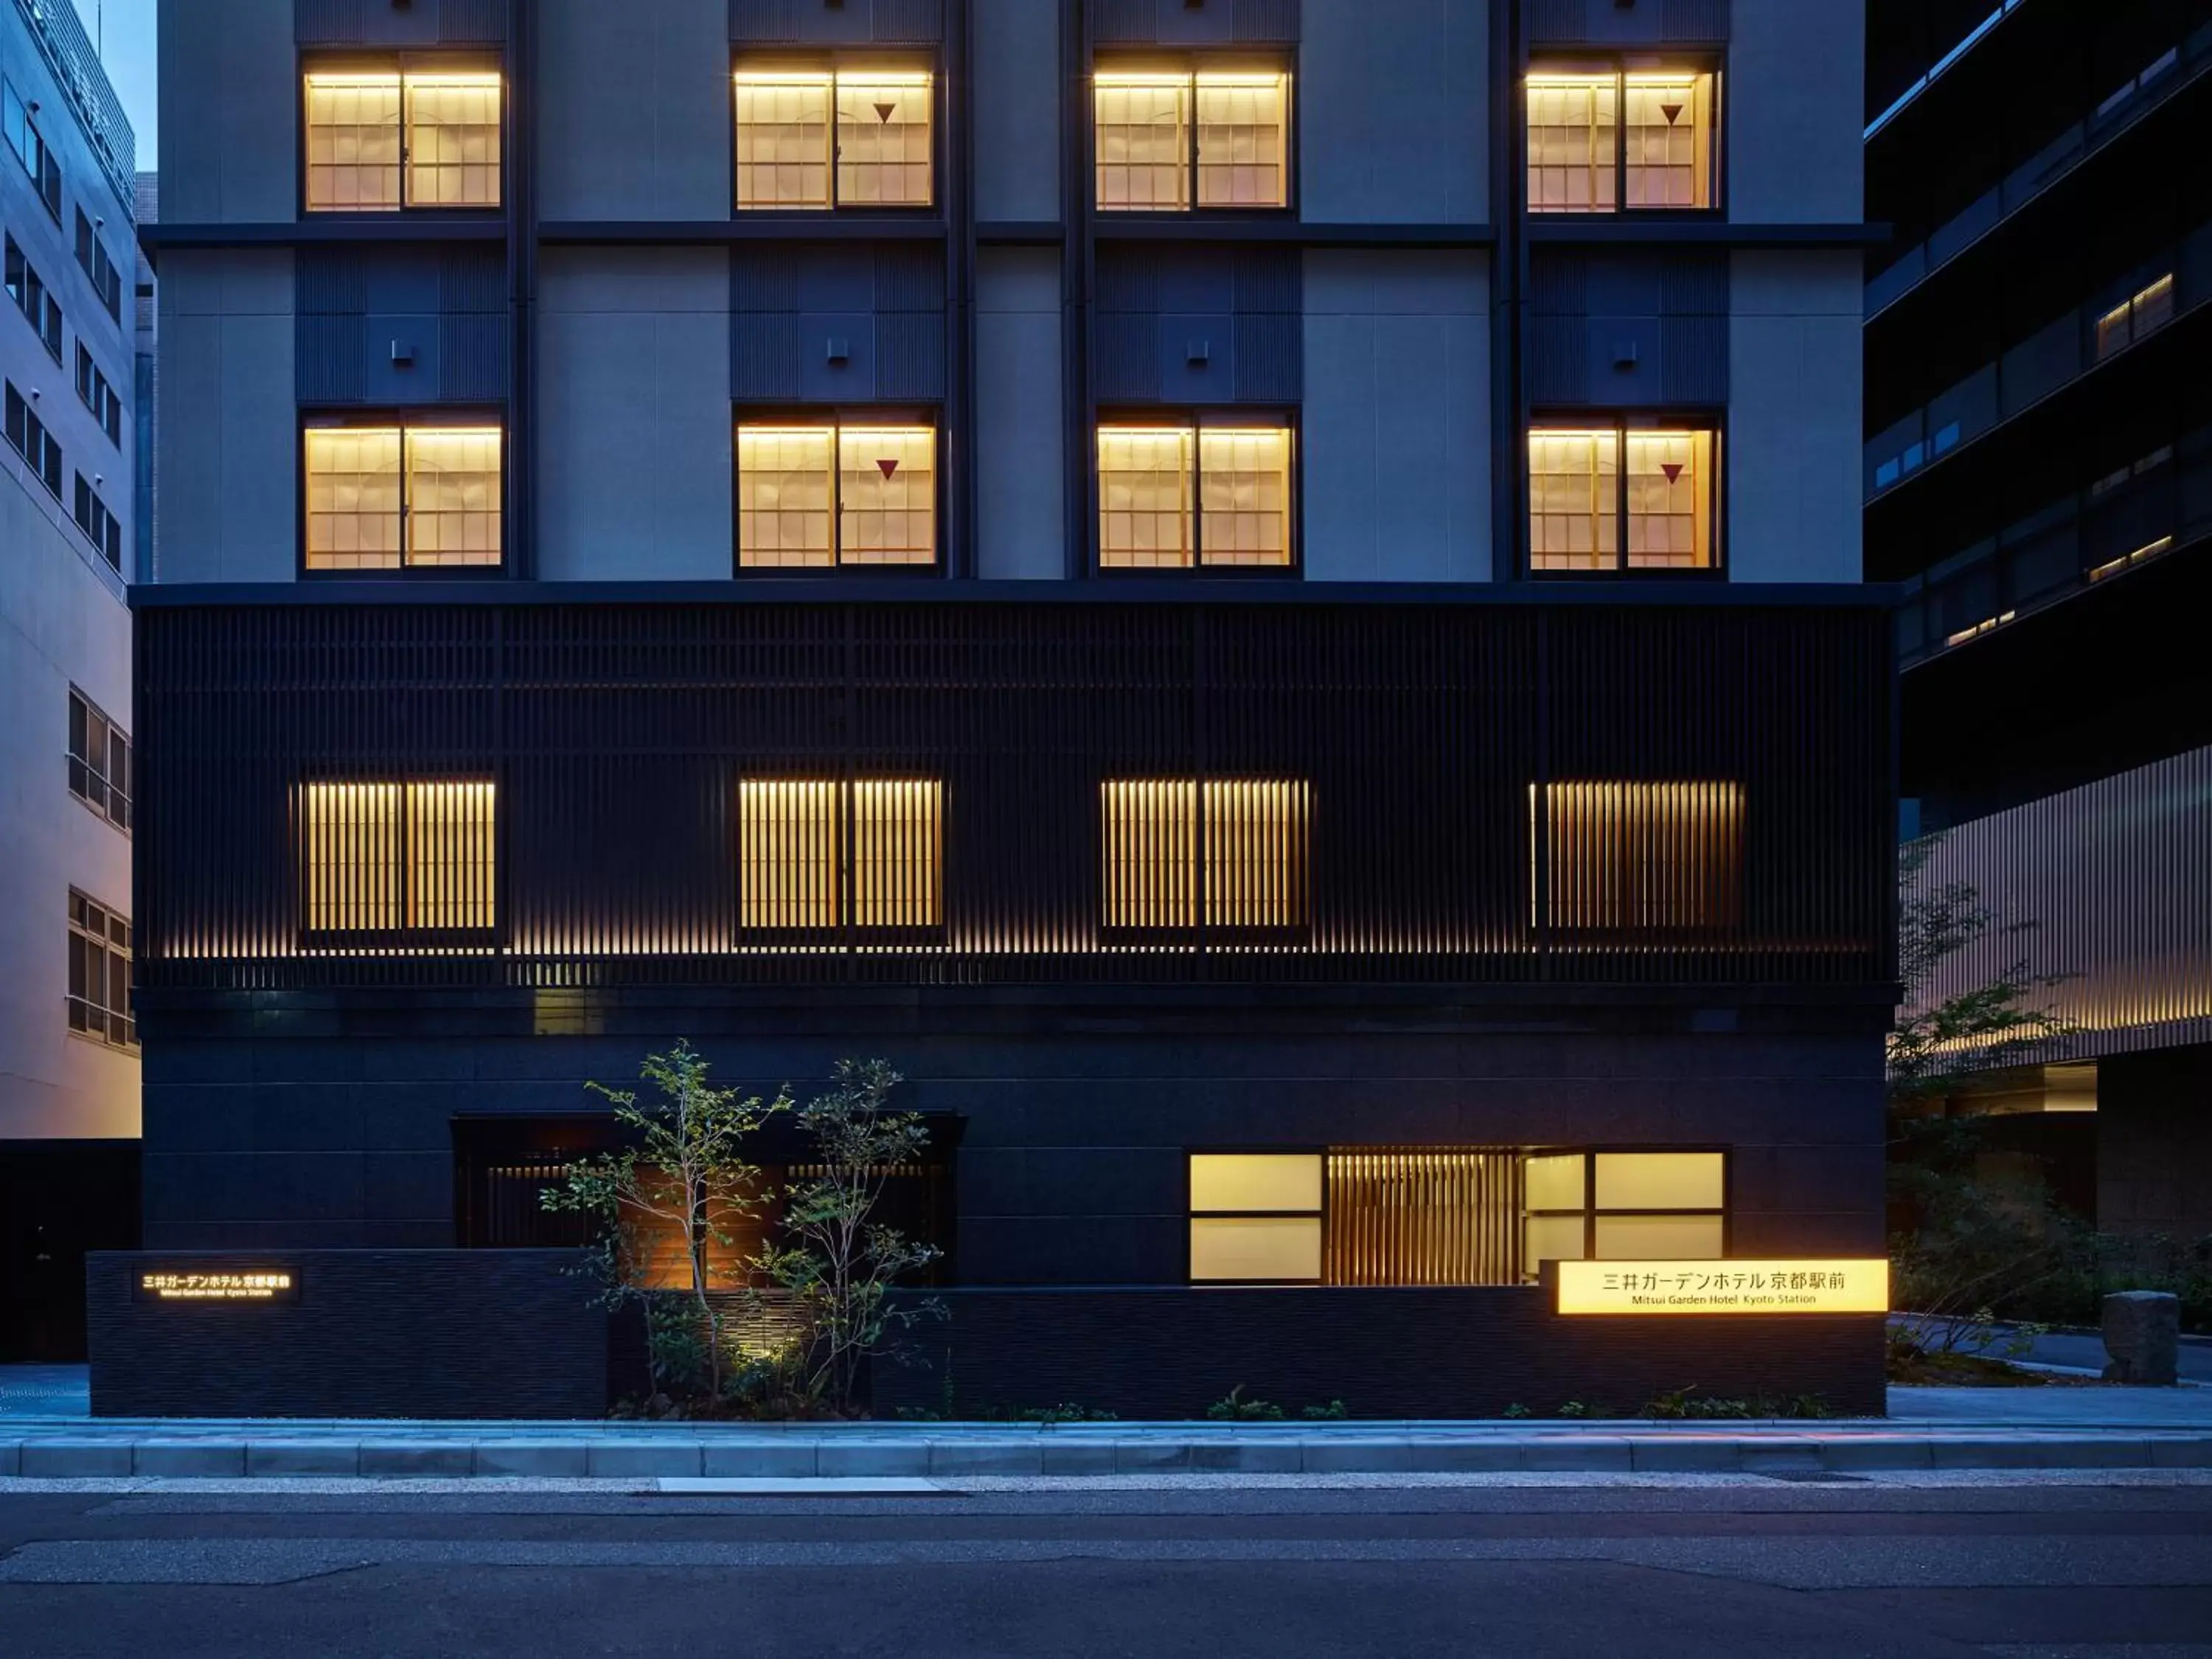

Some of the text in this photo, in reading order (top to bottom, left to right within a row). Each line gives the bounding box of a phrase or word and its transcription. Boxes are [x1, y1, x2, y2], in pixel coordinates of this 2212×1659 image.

[1632, 1294, 1817, 1307] Mitsui Garden Hotel Kyoto Station
